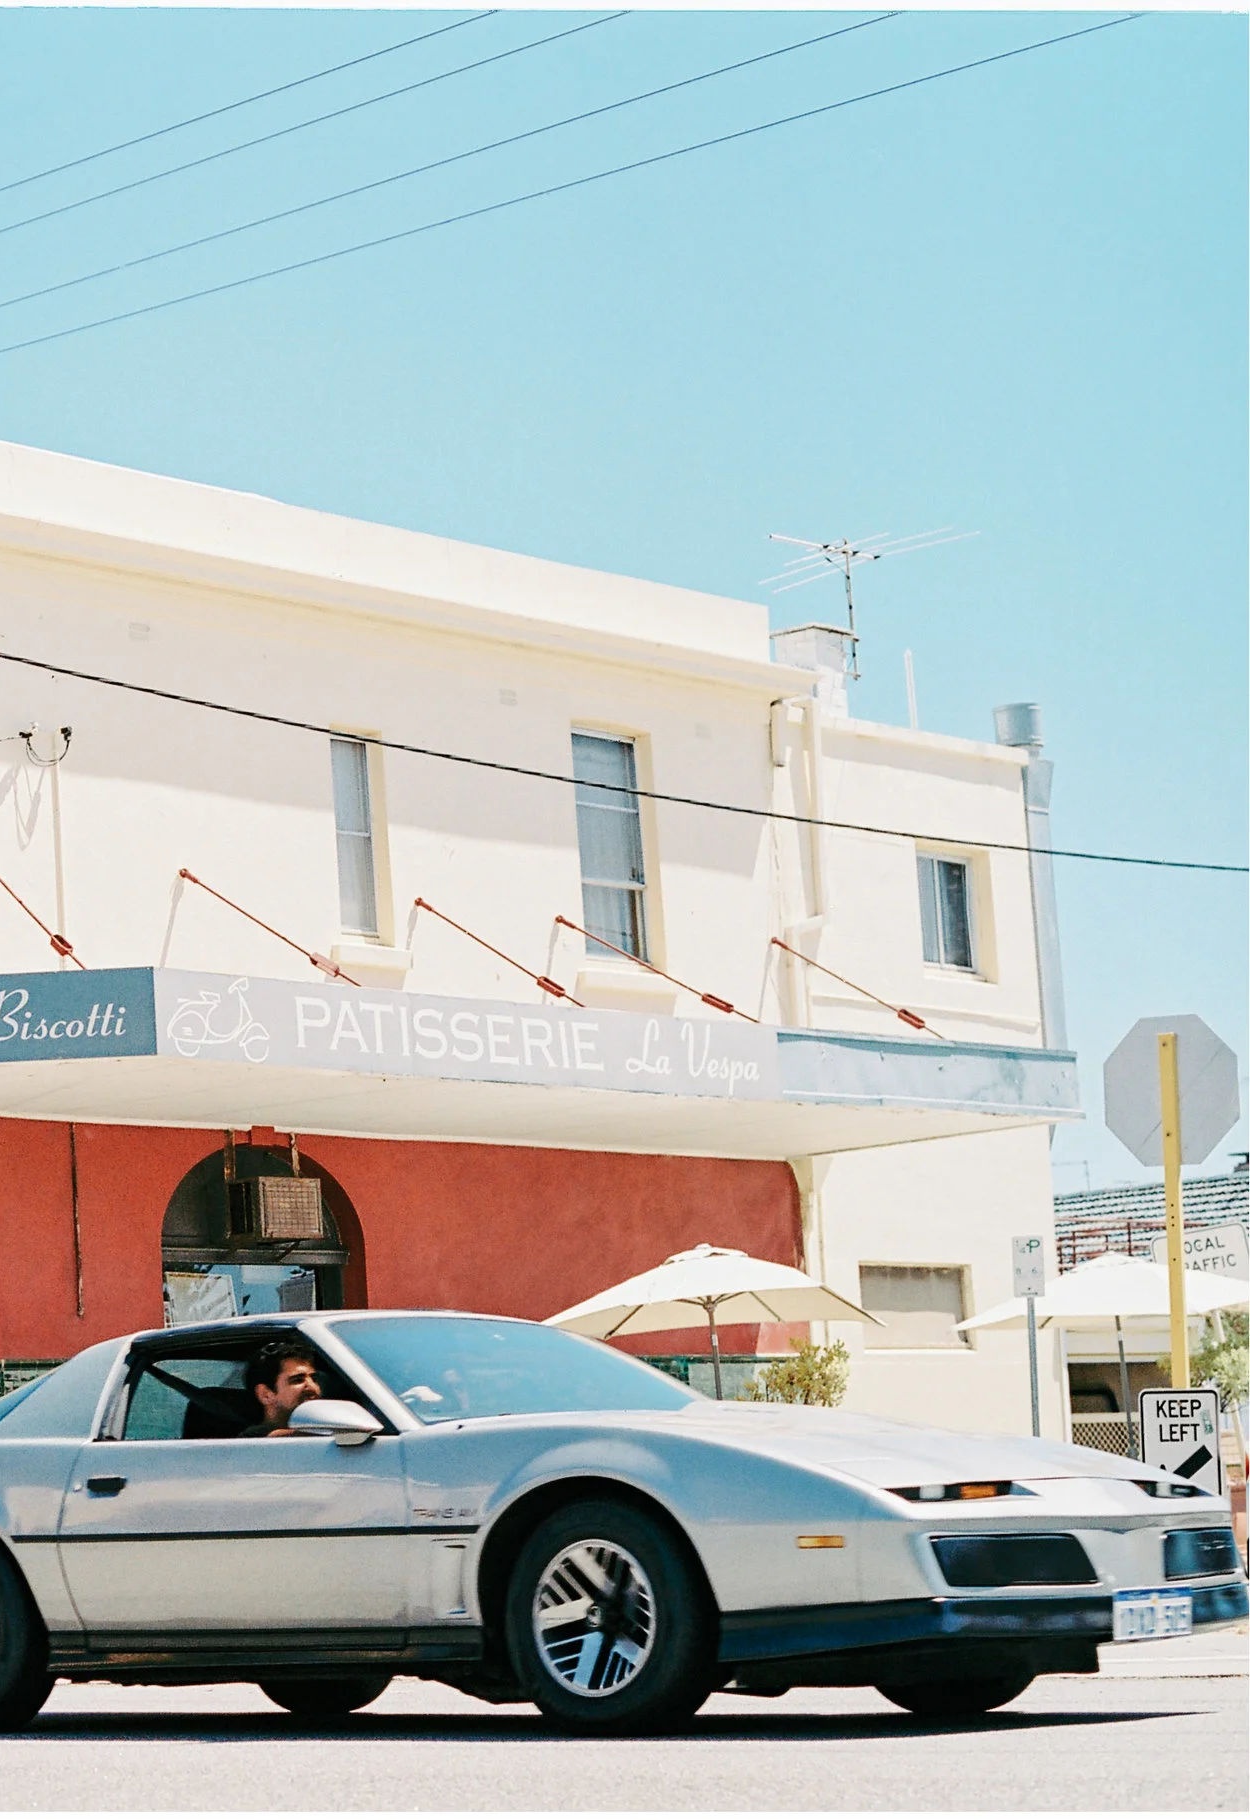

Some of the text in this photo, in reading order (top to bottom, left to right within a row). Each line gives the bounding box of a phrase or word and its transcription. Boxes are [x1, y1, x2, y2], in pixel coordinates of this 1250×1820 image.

[293, 996, 760, 1097] PATISSERIE La Vespa
[1183, 1236, 1225, 1255] OCAL
[1156, 1399, 1202, 1418] KEEP
[1159, 1423, 1201, 1442] LEFT
